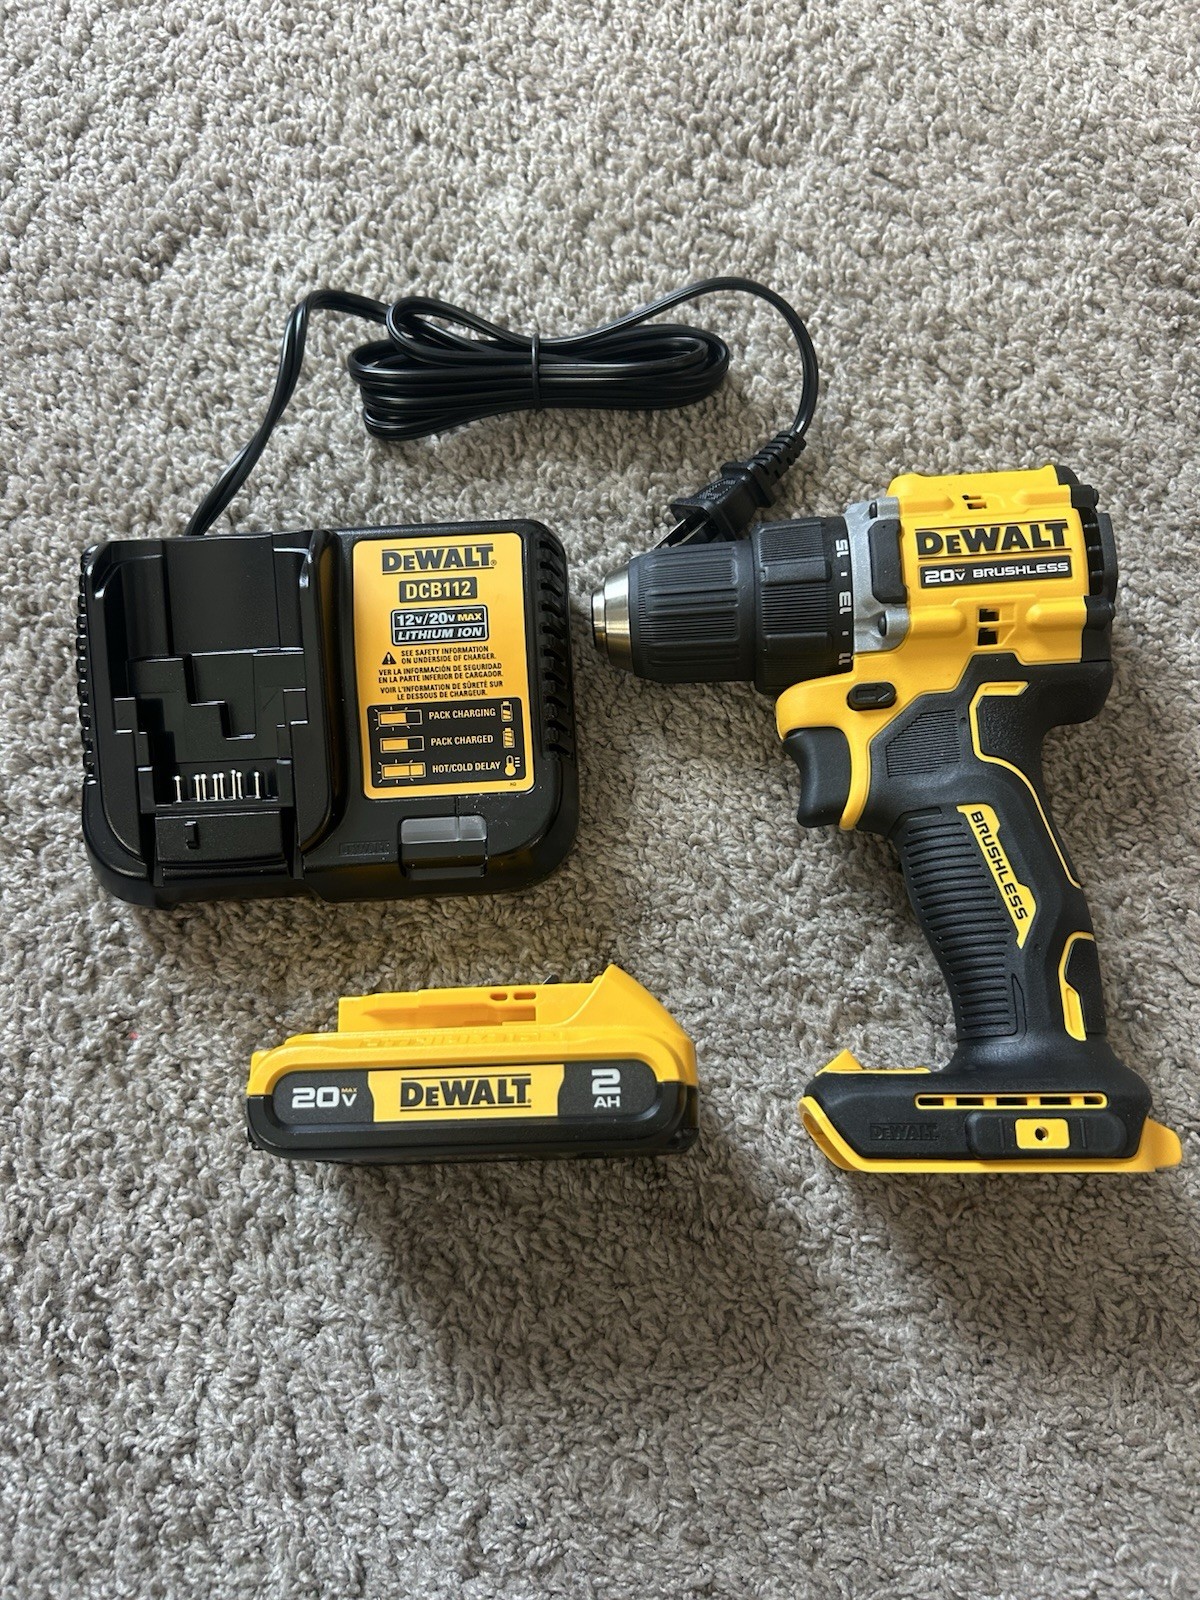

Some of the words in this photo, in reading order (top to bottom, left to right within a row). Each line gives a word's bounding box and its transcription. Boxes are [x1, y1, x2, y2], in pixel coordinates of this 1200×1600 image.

[836, 539, 849, 557] 15
[973, 562, 1068, 578] BRUSHLESS
[406, 581, 471, 600] DCB112
[839, 591, 852, 614] 13
[458, 612, 482, 621] MAX
[398, 628, 454, 641] LITHIUM
[457, 627, 482, 637] ION
[415, 648, 440, 656] SAFETY
[442, 646, 488, 654] INFORMATION
[414, 655, 451, 664] UNDERSIDE
[464, 652, 496, 660] CHARGER.
[838, 652, 851, 666] 11
[404, 665, 451, 674] INFORMACIÓN
[464, 662, 502, 671] SEGURIDAD
[422, 673, 452, 681] INFERIOR
[465, 670, 503, 678] CARGADOR.
[398, 684, 450, 692] L'INFORMATION
[462, 680, 487, 688] SÛRETÉ
[450, 689, 487, 697] CHARGEUR.
[428, 710, 450, 720] PACK
[452, 708, 496, 718] CHARGING
[431, 737, 453, 746] PACK
[454, 735, 493, 745] CHARGED
[432, 762, 473, 774] HOT/COLD
[475, 761, 500, 770] DELAY
[970, 811, 1028, 920] BRUSHLESS
[591, 1068, 621, 1095] 2
[594, 1096, 620, 1108] AH
